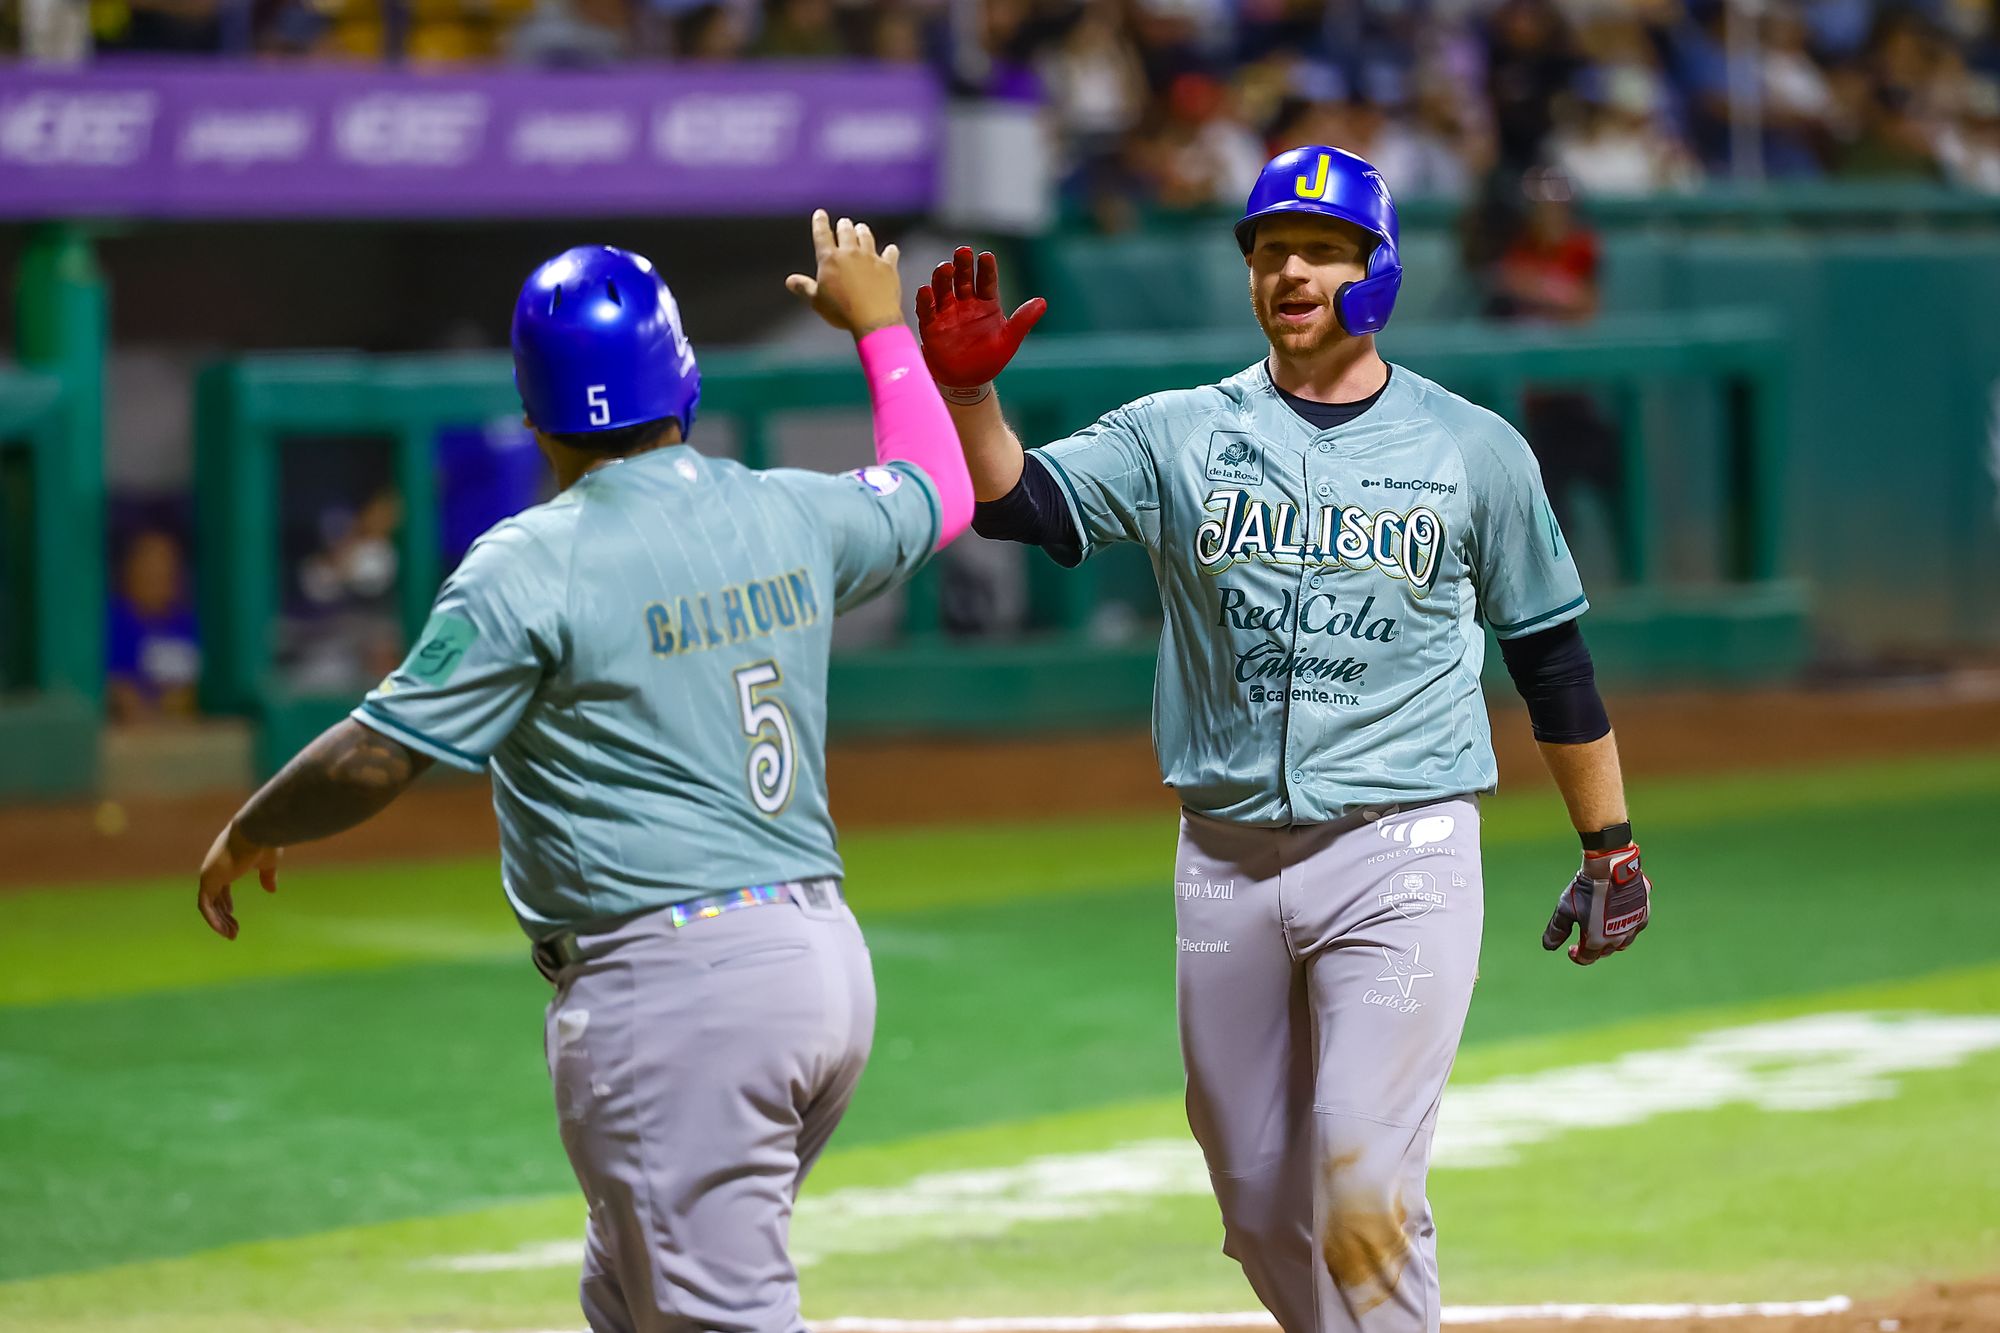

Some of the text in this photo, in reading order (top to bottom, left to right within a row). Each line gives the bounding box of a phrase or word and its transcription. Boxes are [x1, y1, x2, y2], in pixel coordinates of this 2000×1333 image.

[1295, 153, 1331, 200] J
[587, 383, 611, 427] 5
[1209, 467, 1222, 476] de
[1223, 469, 1233, 478] la
[1384, 477, 1458, 495] BanCoppel
[1195, 487, 1446, 600] JALISCO
[644, 567, 819, 660] CALHOUN
[1217, 587, 1294, 633] Red
[1299, 593, 1397, 643] Cola
[1234, 638, 1369, 684] Caliente
[733, 658, 798, 818] 5
[1367, 846, 1457, 866] HONEY WHALE
[1201, 879, 1236, 900] Azul
[1362, 989, 1401, 1009] Carl's
